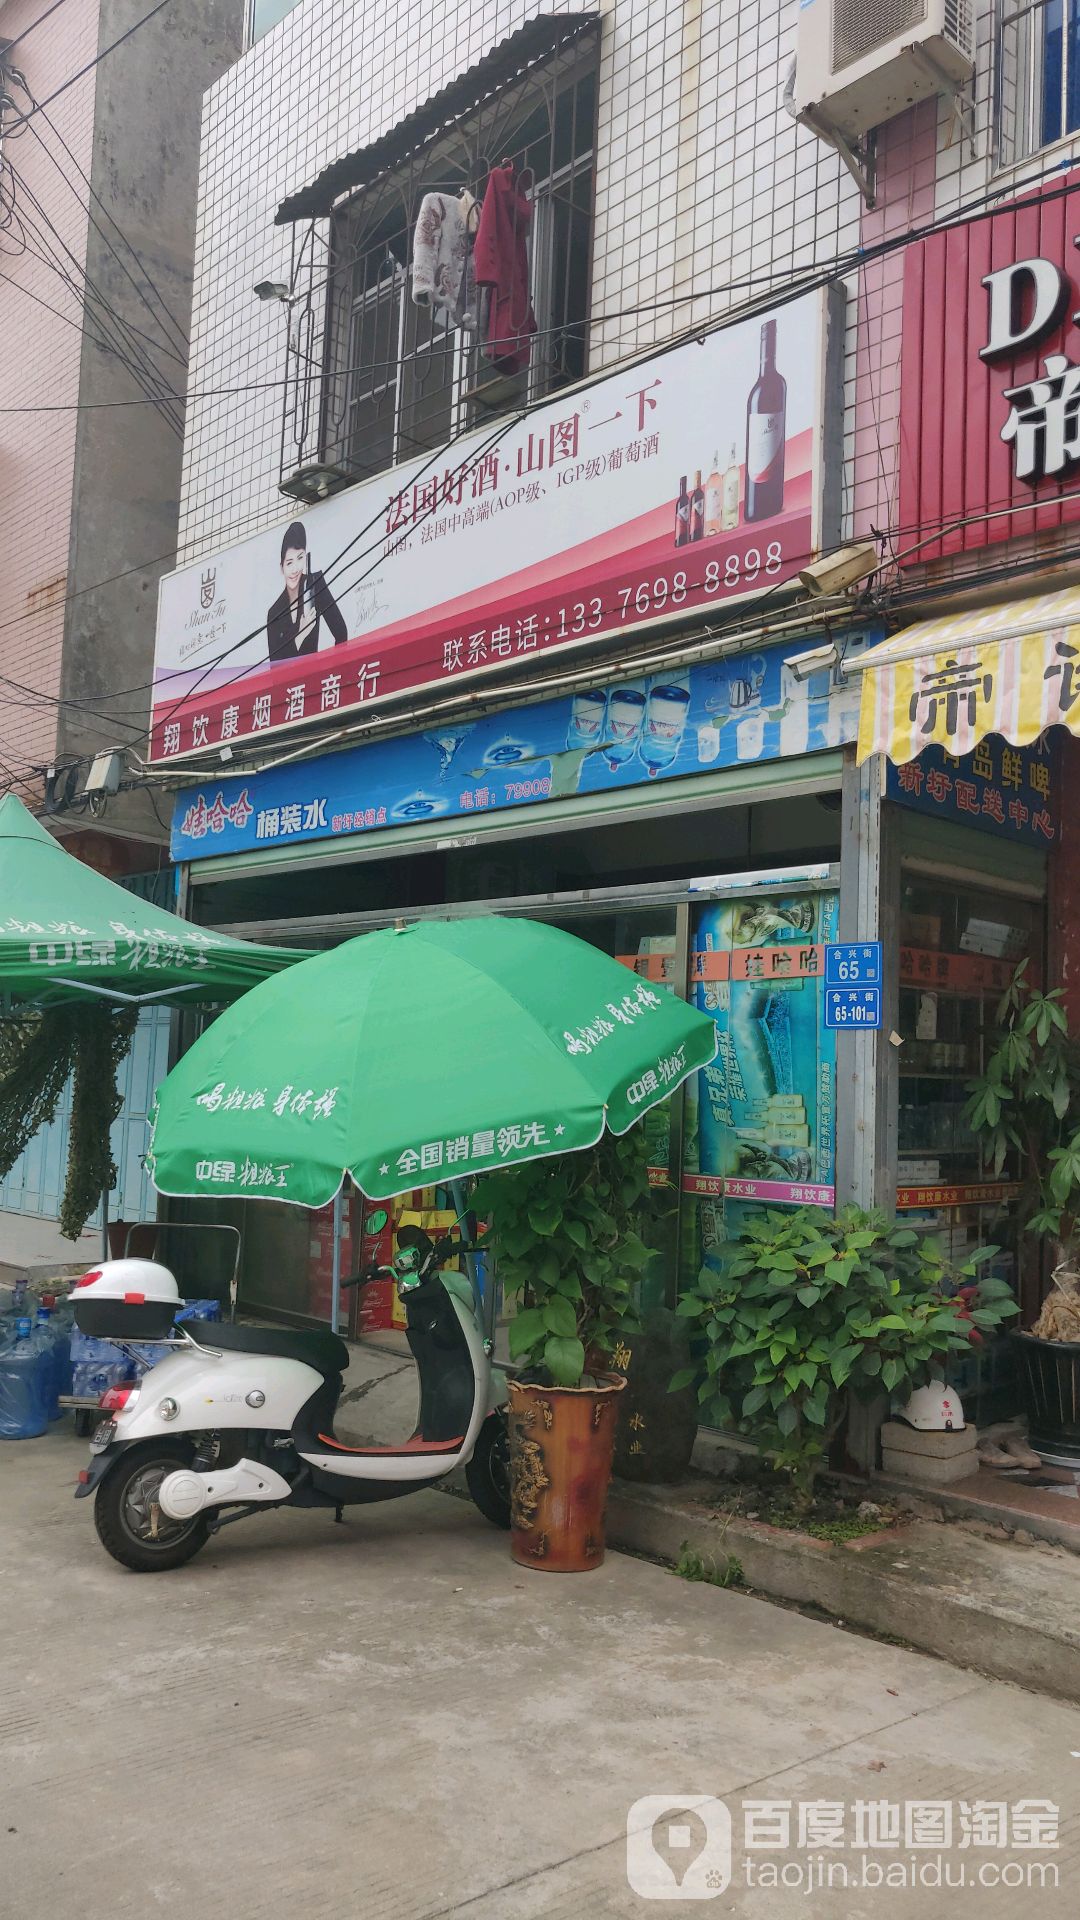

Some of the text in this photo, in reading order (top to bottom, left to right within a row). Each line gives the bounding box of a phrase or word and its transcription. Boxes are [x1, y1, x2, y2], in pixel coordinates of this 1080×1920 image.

[979, 236, 1080, 358] D
[163, 661, 381, 755] 翔饮康烟酒商行
[181, 788, 255, 839] 娃哈哈
[898, 763, 1055, 839] 新圩配送中心
[256, 799, 328, 839] 桶装水
[332, 807, 387, 832] 新圩经销点
[834, 948, 872, 960] 合兴街
[839, 961, 859, 980] 65
[832, 992, 874, 1003] 合兴街
[835, 1005, 866, 1021] 65-101
[396, 1121, 551, 1177] 全国销量领先
[790, 1187, 835, 1203] 翔饮康
